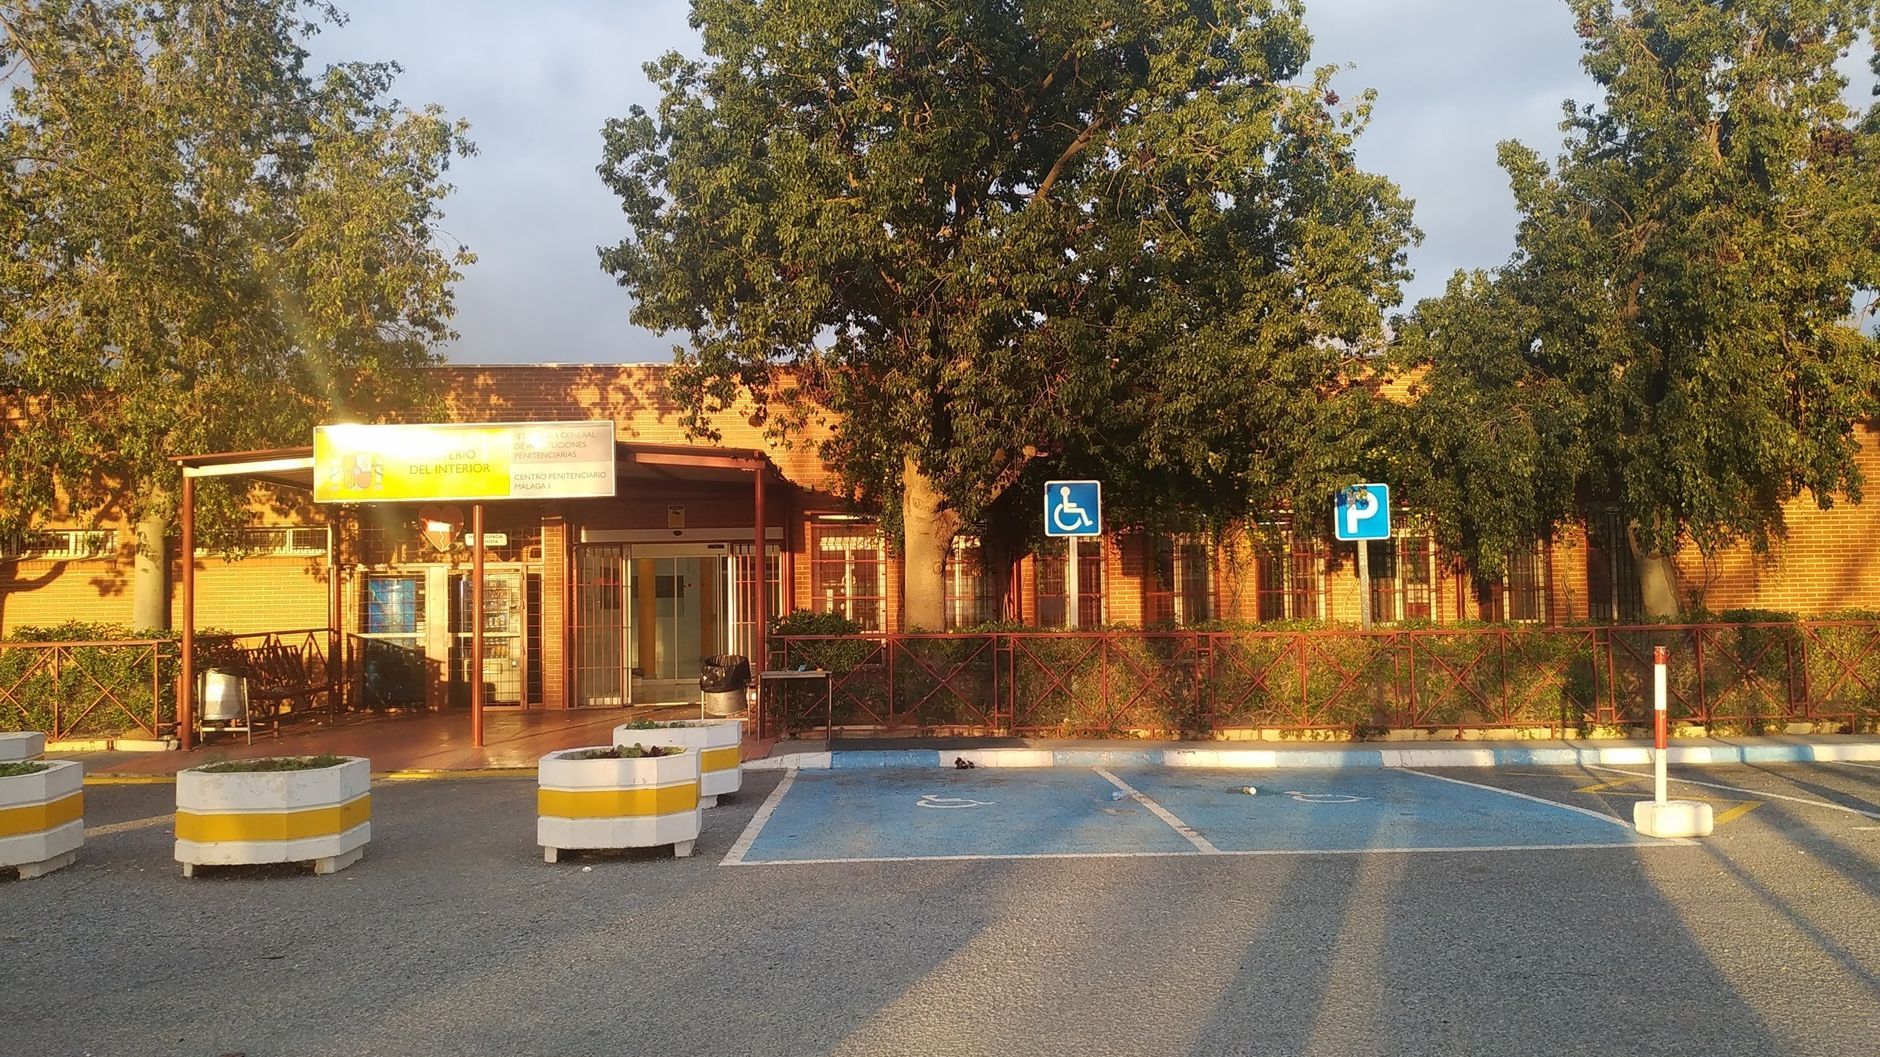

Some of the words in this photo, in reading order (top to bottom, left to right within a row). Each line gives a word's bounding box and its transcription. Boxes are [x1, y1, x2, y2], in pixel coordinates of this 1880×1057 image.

[560, 431, 597, 439] GENERAL
[514, 450, 577, 459] PENITENCIARIAS
[409, 464, 431, 475] DEL
[435, 463, 491, 474] INTERIOR
[514, 473, 547, 481] CENTRO
[549, 471, 607, 480] PENITENCIARIO
[1347, 491, 1379, 534] P
